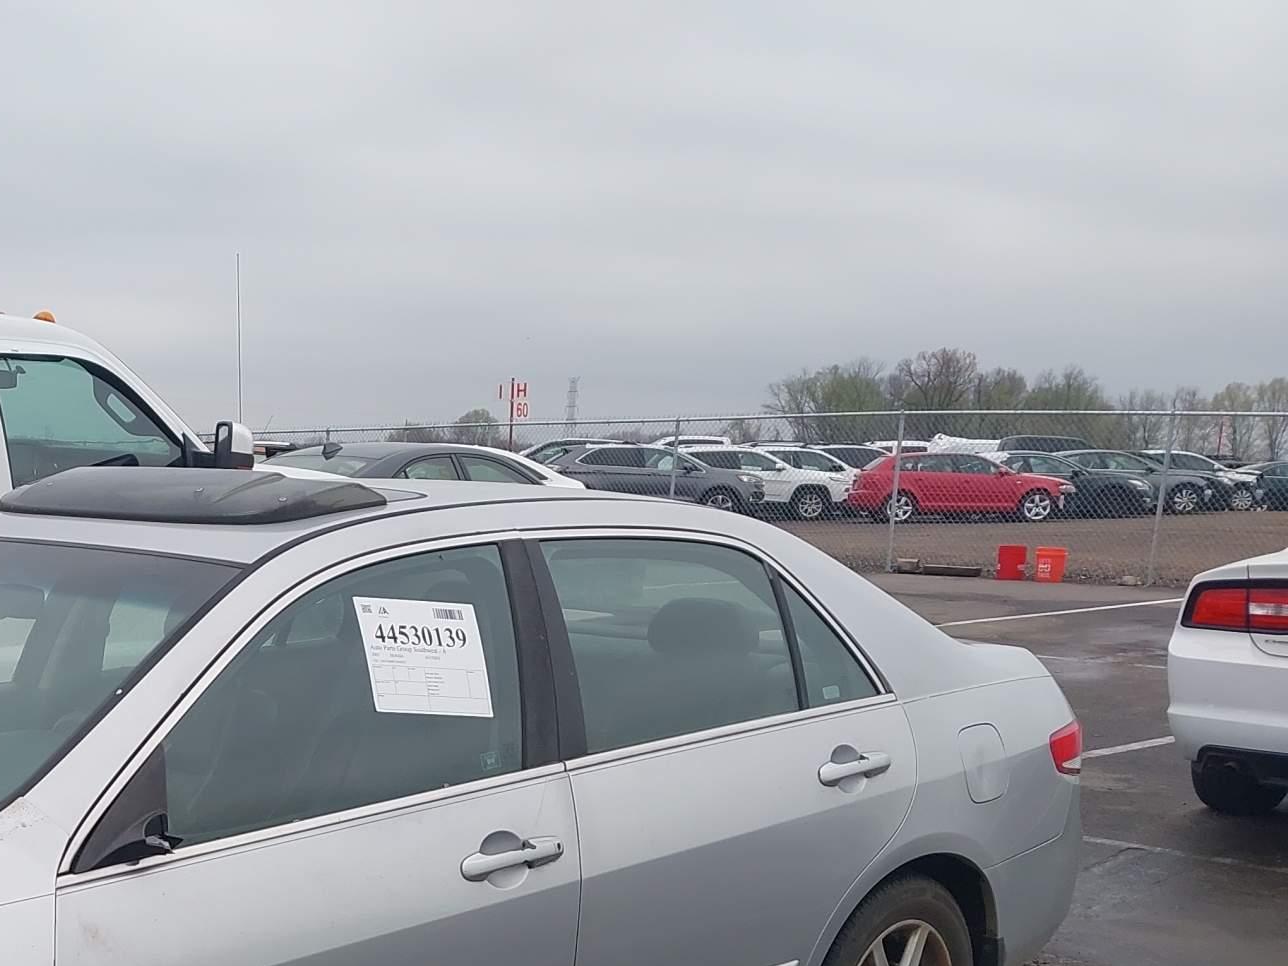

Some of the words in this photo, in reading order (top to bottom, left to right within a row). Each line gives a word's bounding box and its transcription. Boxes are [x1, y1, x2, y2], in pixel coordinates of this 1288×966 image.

[516, 382, 528, 398] H
[516, 402, 529, 418] 60
[374, 623, 467, 649] 44530139
